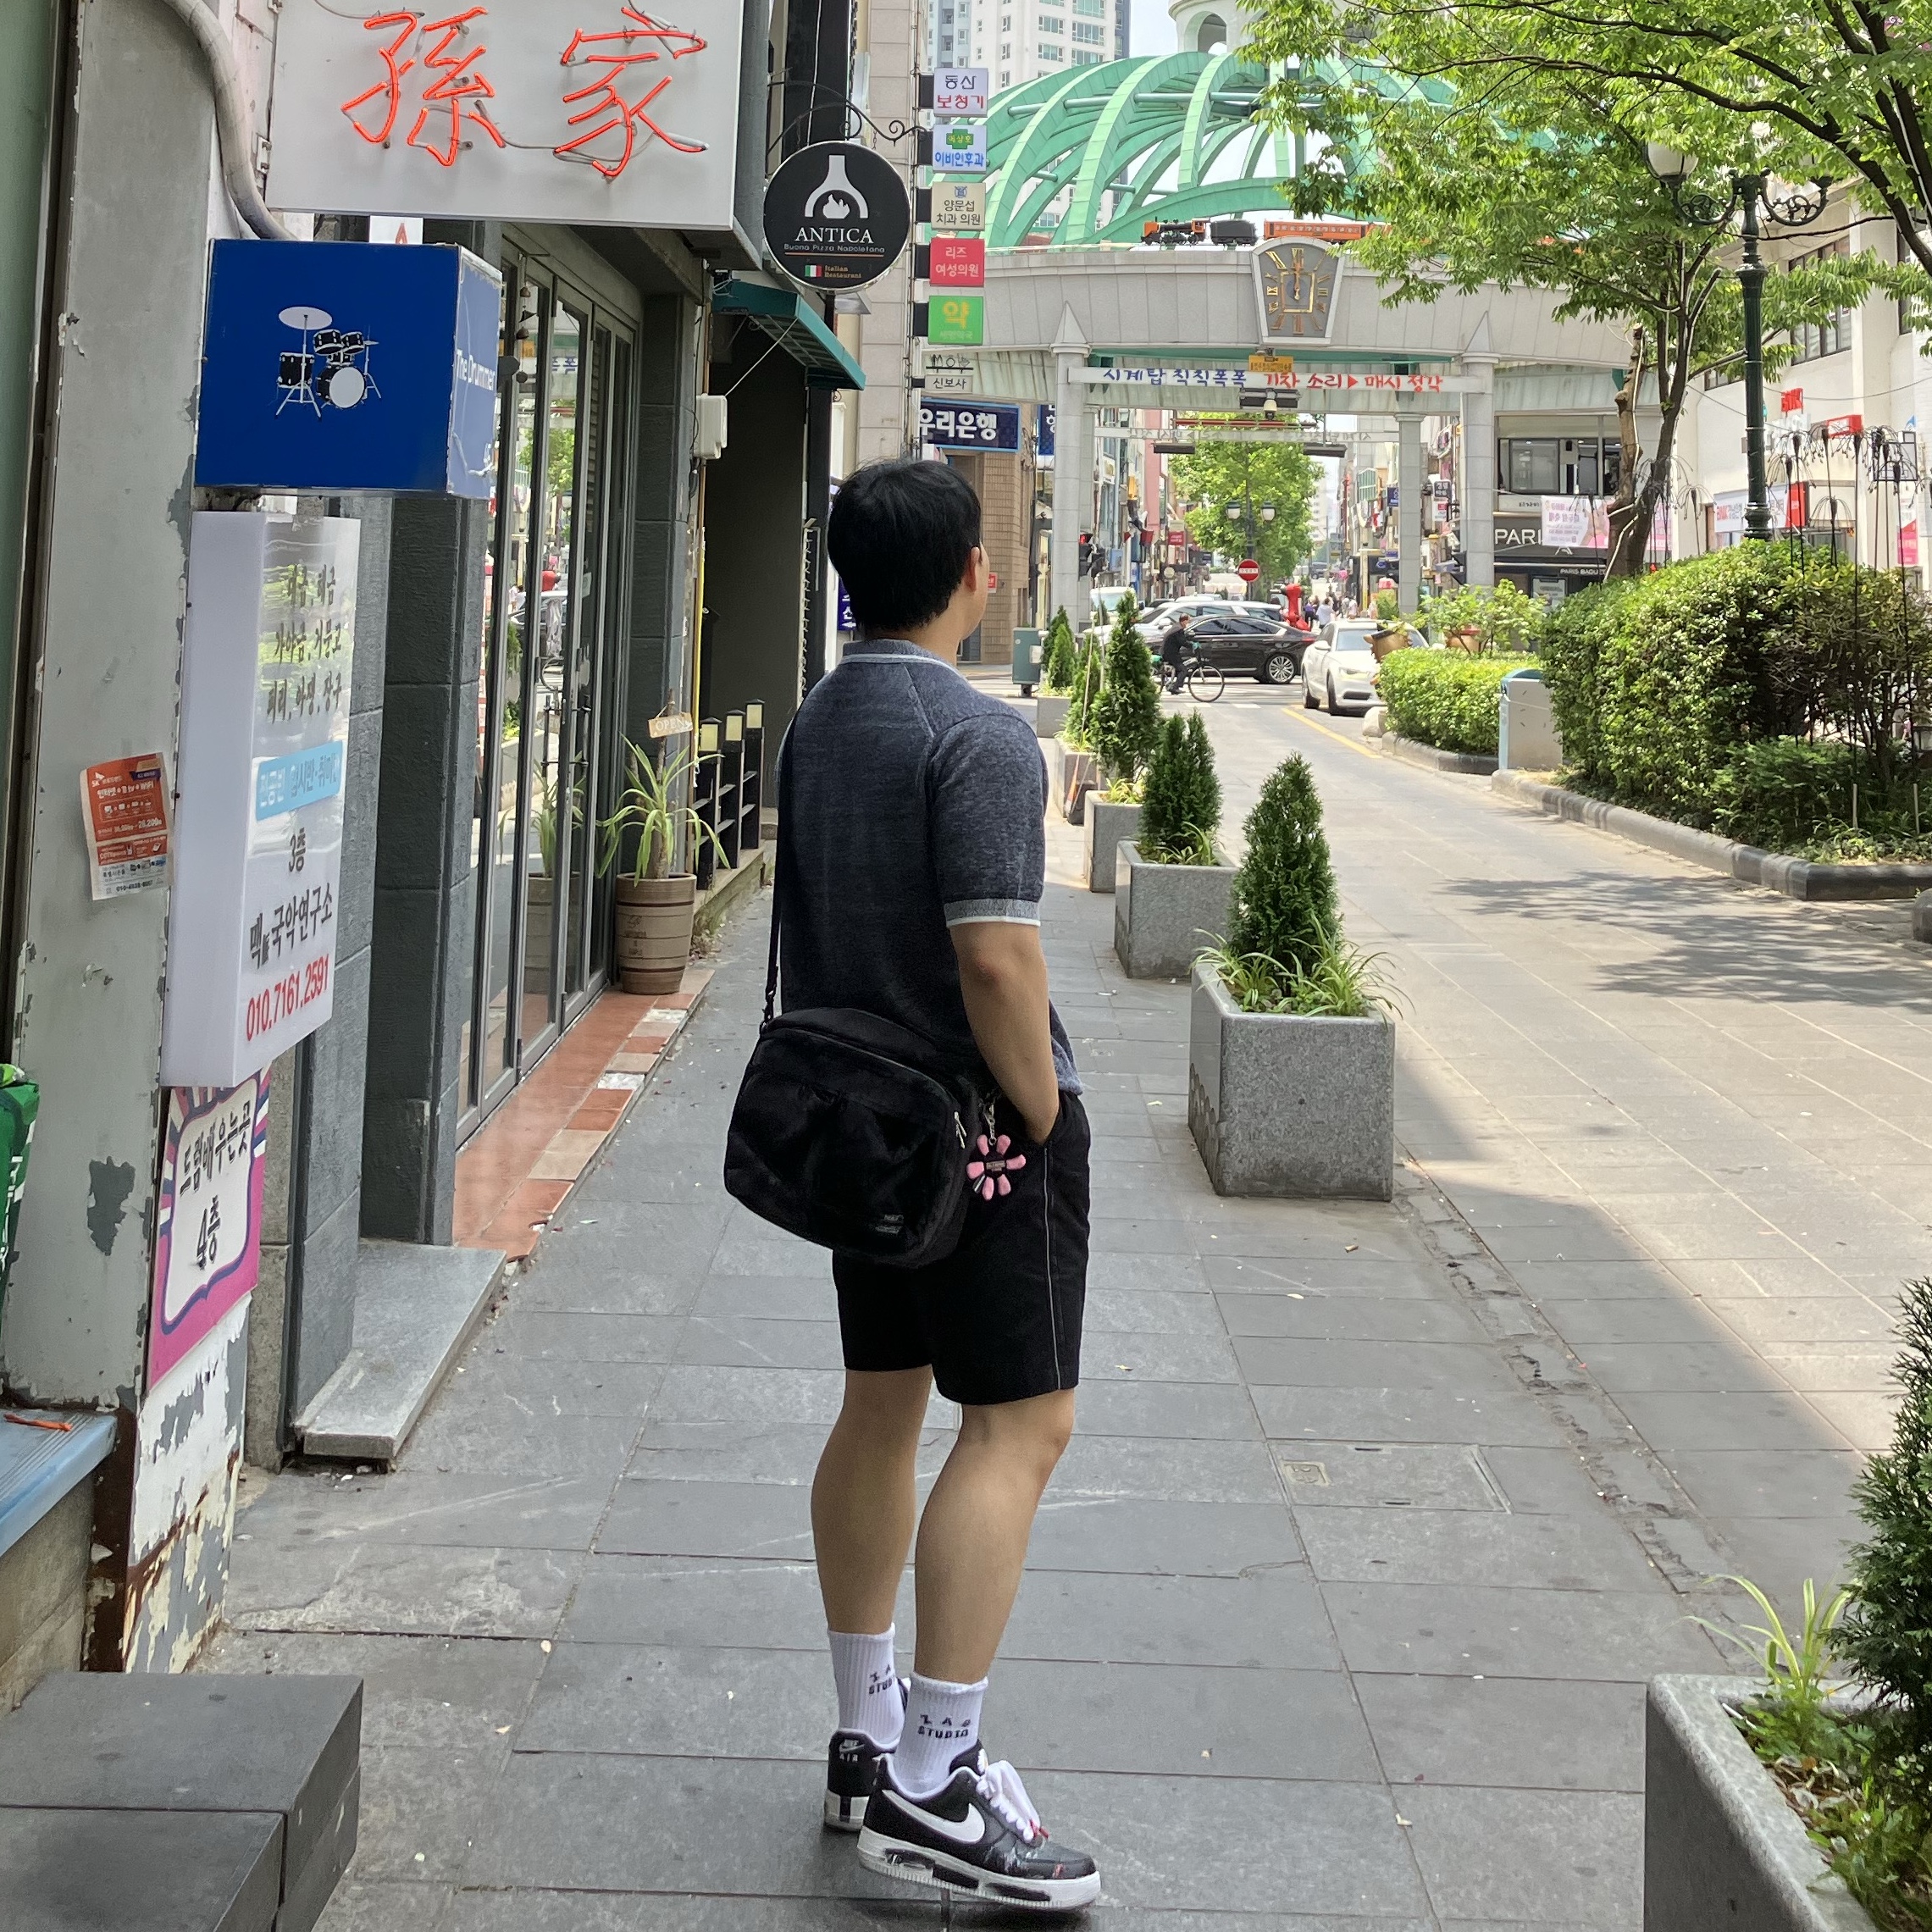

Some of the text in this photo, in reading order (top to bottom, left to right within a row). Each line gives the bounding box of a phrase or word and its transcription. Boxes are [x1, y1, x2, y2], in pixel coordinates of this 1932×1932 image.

[938, 94, 984, 109] 보청기
[935, 152, 984, 167] 이비인후과
[944, 200, 975, 212] 양문섭
[937, 213, 981, 225] 치과 의원
[794, 227, 874, 244] ANTICA
[945, 246, 967, 259] 리즈
[936, 263, 979, 277] 여성의원
[943, 301, 971, 329] 약
[933, 378, 966, 390] 신보사
[1104, 368, 1443, 393] 시계탑 칙칙폭폭 기차 소리 매시 정각
[919, 408, 997, 440] 우리은행
[1495, 529, 1542, 545] PARI
[656, 717, 686, 730] OPEN
[289, 828, 306, 872] 3층
[246, 954, 329, 1041] 010.7161.2591
[197, 1195, 220, 1270] 4층
[918, 1725, 968, 1738] STUDIO
